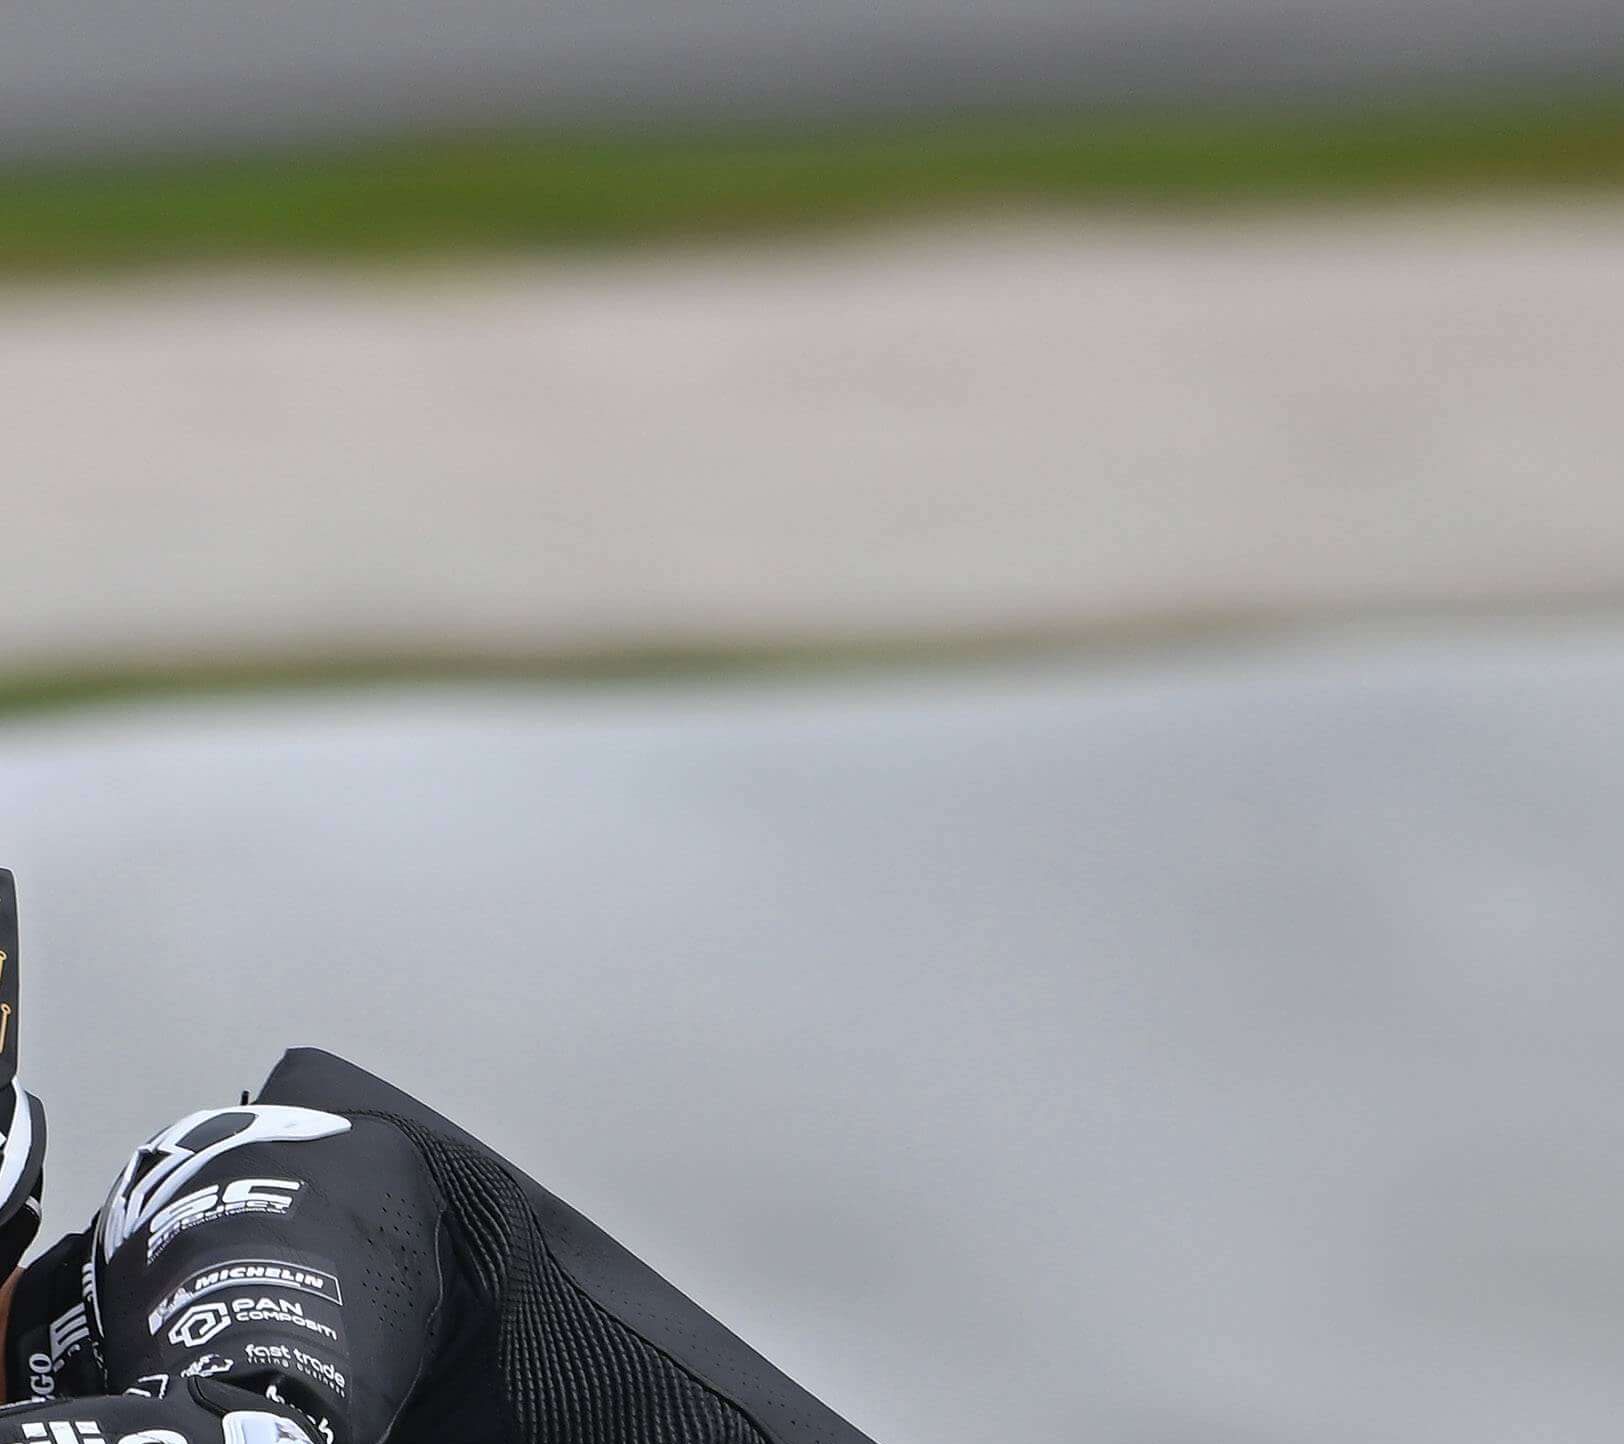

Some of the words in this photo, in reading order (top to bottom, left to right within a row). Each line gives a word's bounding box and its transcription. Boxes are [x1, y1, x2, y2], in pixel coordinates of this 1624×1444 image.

[195, 1266, 324, 1290] MICHELIN
[232, 1298, 303, 1316] PAN
[245, 1344, 291, 1359] fast
[293, 1348, 346, 1388] trade
